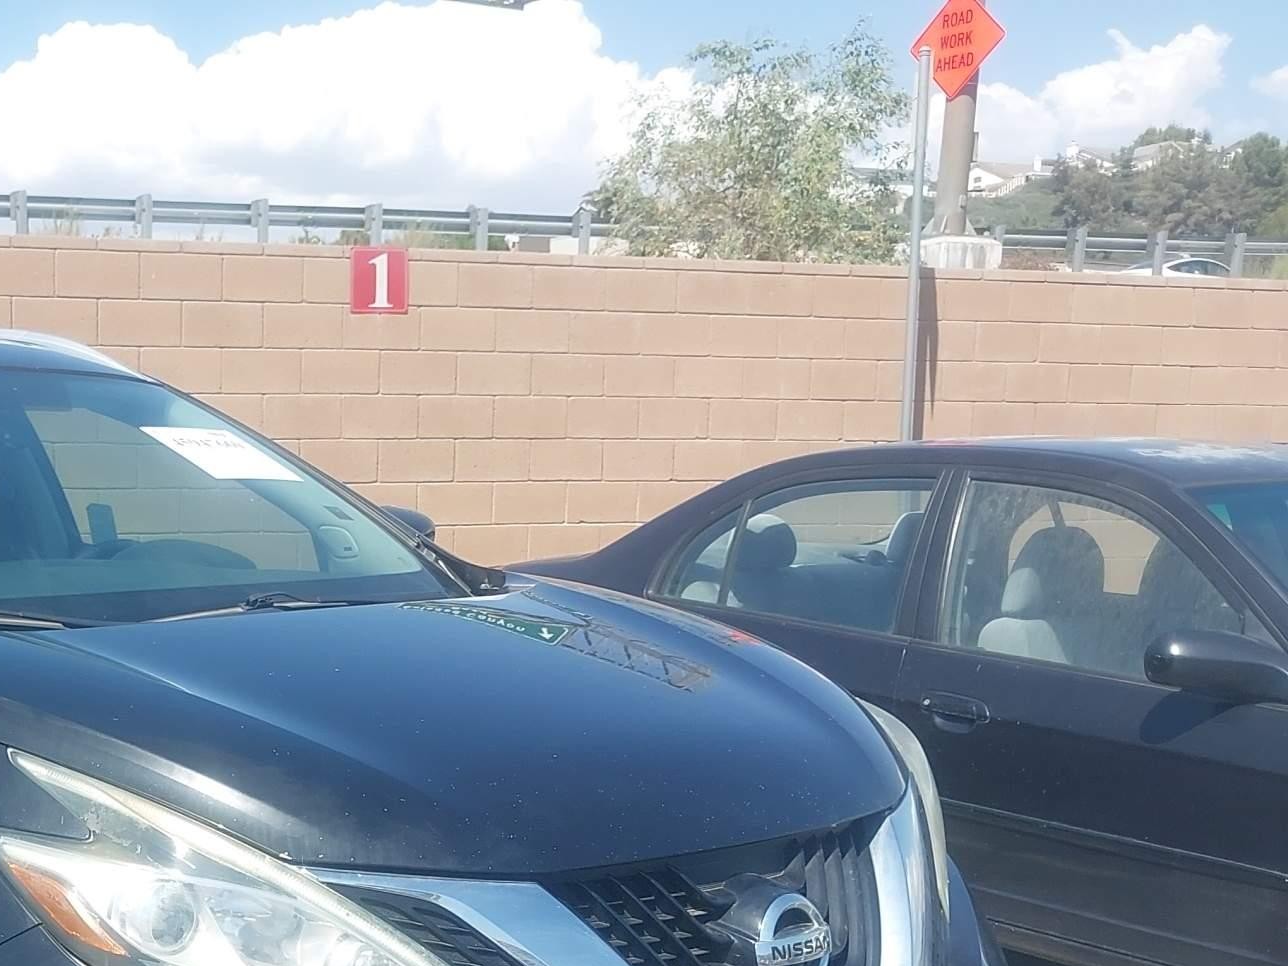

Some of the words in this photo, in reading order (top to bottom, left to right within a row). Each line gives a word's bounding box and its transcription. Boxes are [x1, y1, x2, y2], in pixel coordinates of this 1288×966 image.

[942, 9, 974, 29] ROAD
[940, 30, 974, 50] WORK
[936, 52, 974, 73] AHEAD
[367, 252, 394, 308] 1
[770, 935, 830, 961] NISSAN
